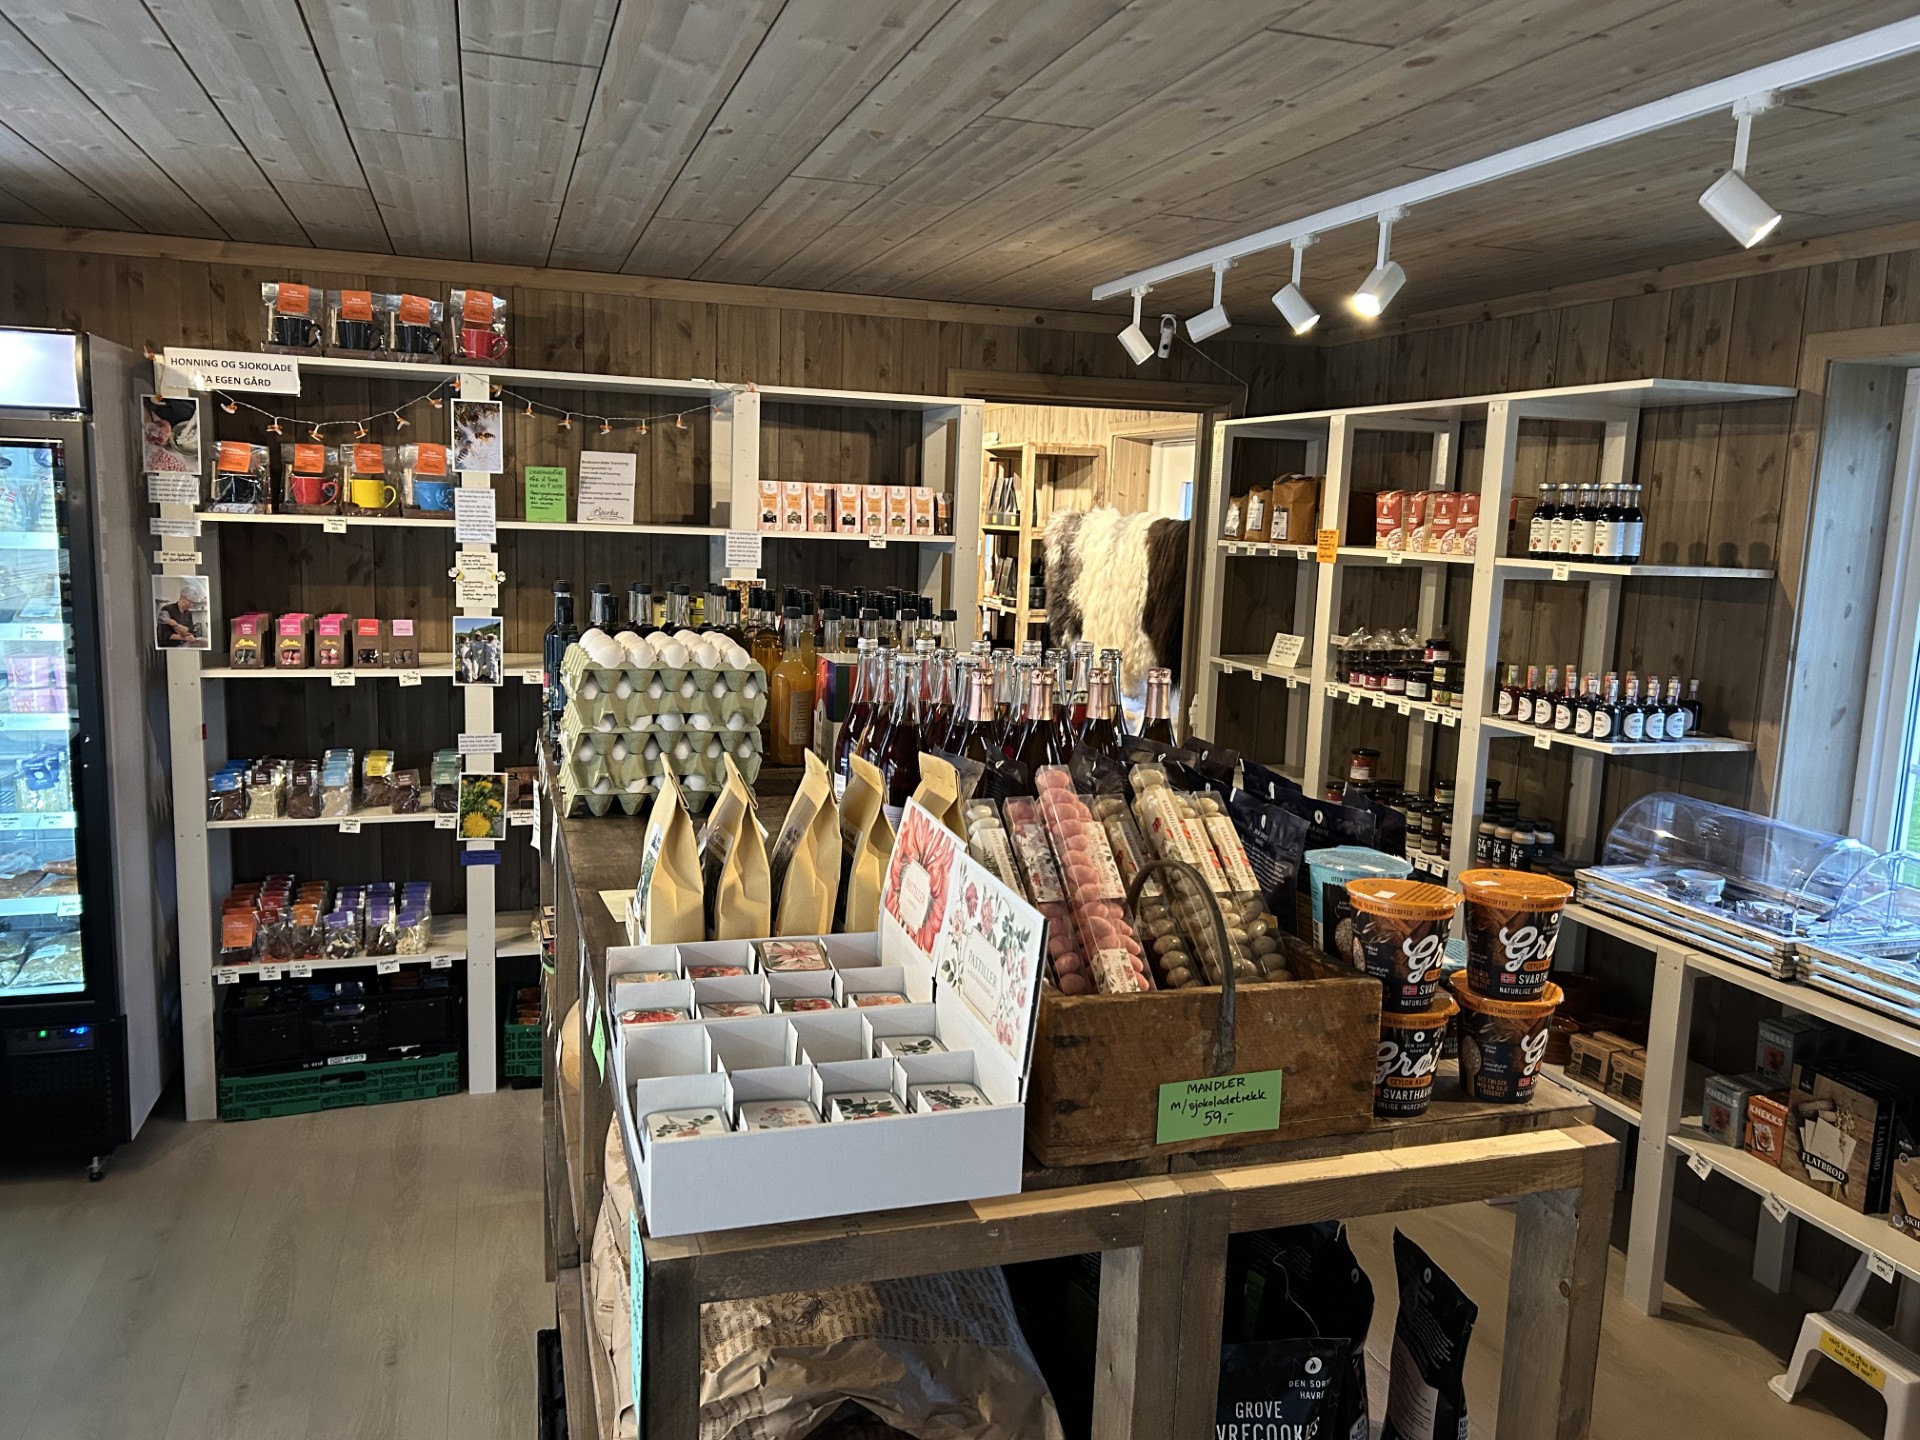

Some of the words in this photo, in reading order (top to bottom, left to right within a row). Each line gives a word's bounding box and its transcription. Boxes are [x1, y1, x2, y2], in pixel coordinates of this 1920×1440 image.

[170, 357, 218, 368] HONNING
[221, 360, 236, 369] OG
[239, 361, 292, 372] SJOKOLADE
[215, 375, 241, 385] EGEN
[244, 376, 271, 387] GÅRD
[1498, 926, 1558, 972] Grø
[968, 949, 998, 987] PASTILLER
[1402, 934, 1444, 984] Gr
[1518, 972, 1548, 985] SVARTH
[1500, 986, 1531, 995] NATURLIGE
[1759, 1027, 1792, 1049] KNEKKS
[1187, 1077, 1246, 1094] MANDLER
[1170, 1088, 1268, 1118] m/sjokoladetrekk
[1376, 1101, 1400, 1110] URLIGE
[1706, 1086, 1738, 1108] KNEKKS
[1203, 1110, 1234, 1127] 59,-
[1750, 1104, 1784, 1127] KNEKKS
[1289, 1380, 1306, 1388] DEN
[1309, 1377, 1332, 1388] SORT
[1300, 1390, 1325, 1400] HAVRE
[1235, 1400, 1283, 1419] GROVE
[1216, 1416, 1320, 1440] VRECOOKIES
